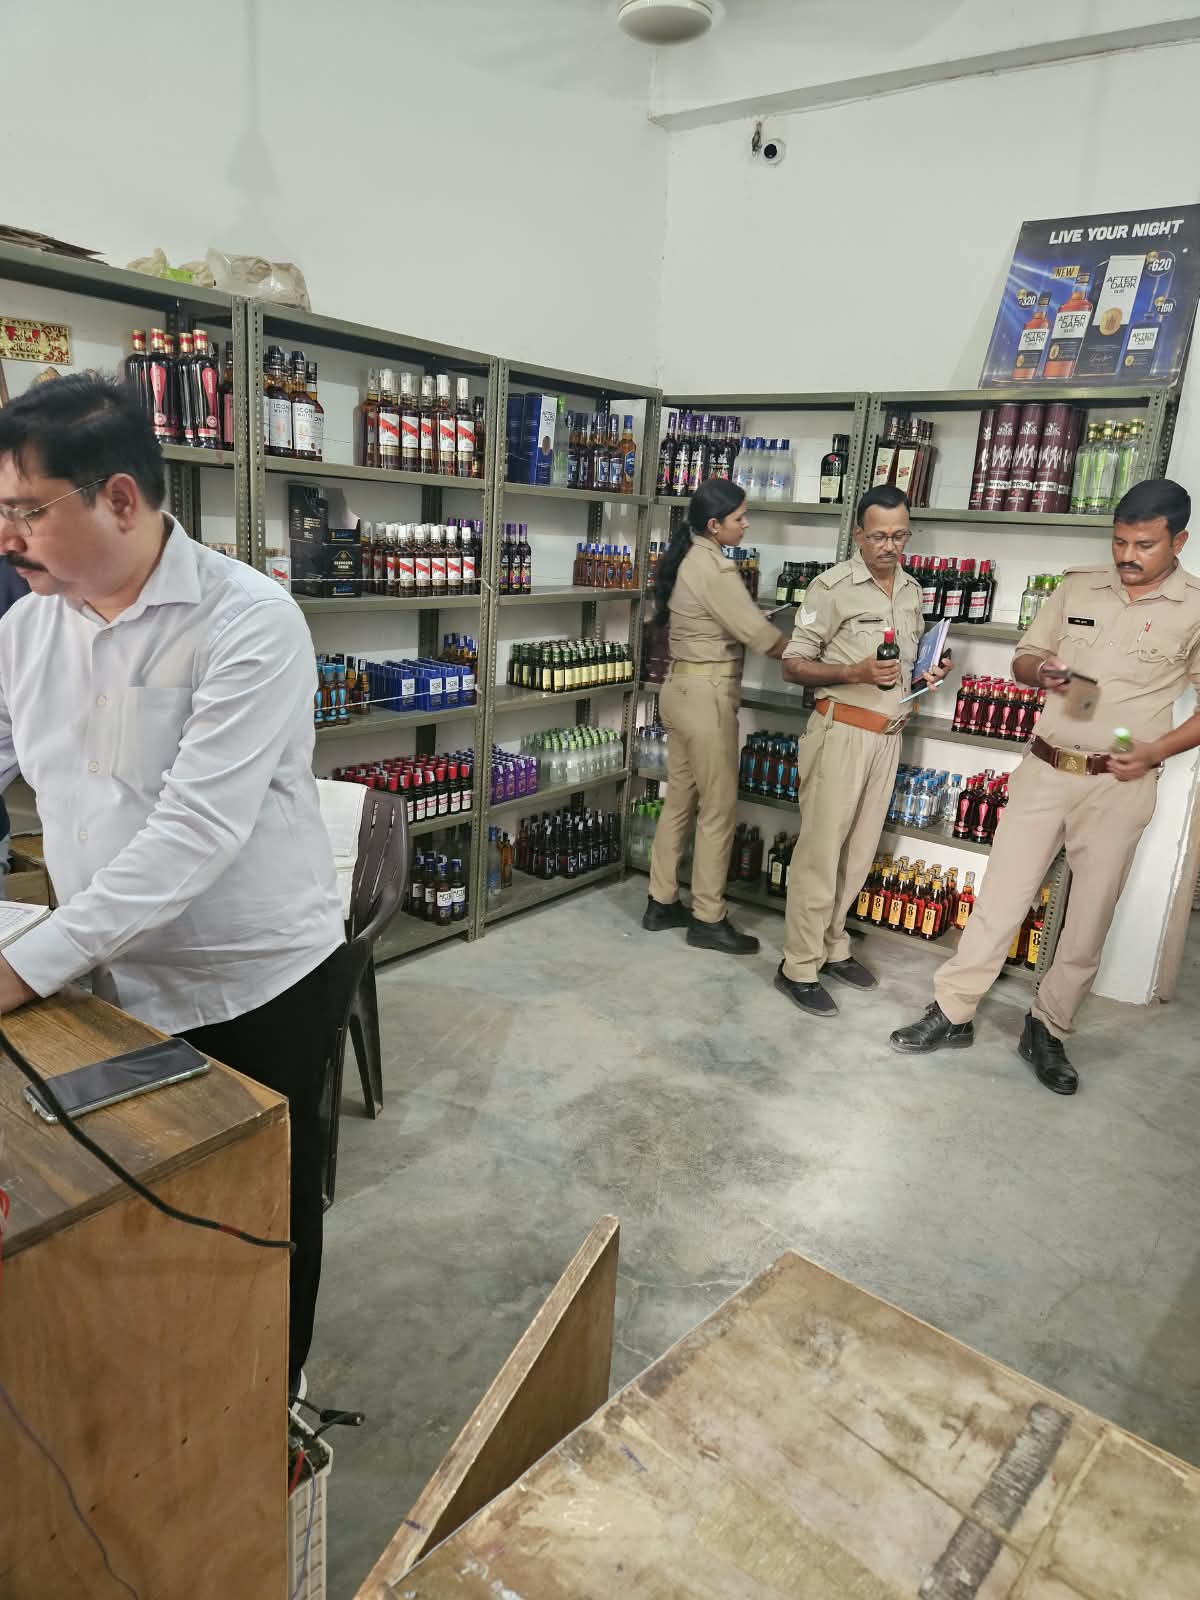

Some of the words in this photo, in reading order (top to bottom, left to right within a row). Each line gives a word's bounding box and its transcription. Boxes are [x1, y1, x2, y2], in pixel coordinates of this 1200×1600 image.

[1049, 230, 1083, 244] LIVE
[1087, 224, 1128, 241] YOUR
[1132, 219, 1185, 237] NIGHT
[1055, 267, 1075, 278] NEW
[1111, 281, 1136, 289] DARK
[861, 893, 867, 902] 8
[875, 898, 881, 908] 8
[893, 901, 899, 912] 8
[960, 903, 967, 912] 8
[908, 905, 914, 915] 8
[926, 910, 932, 920] 8
